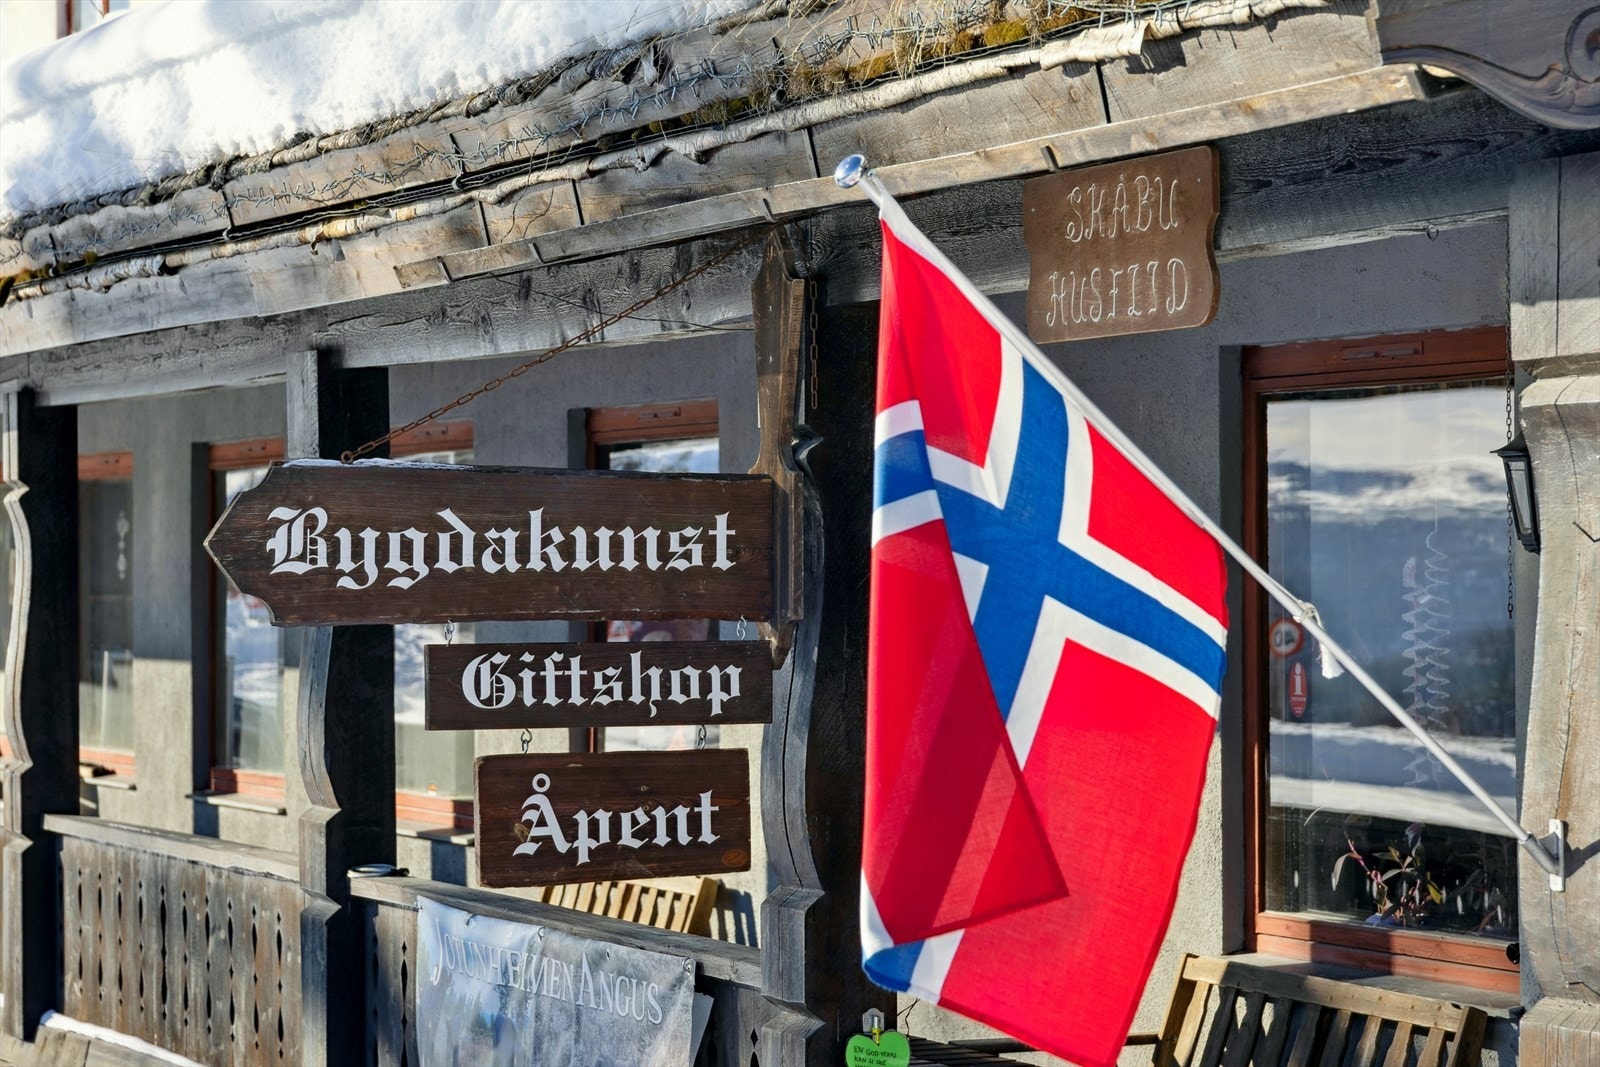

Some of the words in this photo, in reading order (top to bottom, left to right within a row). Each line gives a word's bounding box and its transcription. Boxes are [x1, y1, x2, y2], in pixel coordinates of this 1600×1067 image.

[265, 506, 736, 590] Bygdakunst
[461, 650, 742, 718] Giftshop
[512, 772, 720, 866] Åpent
